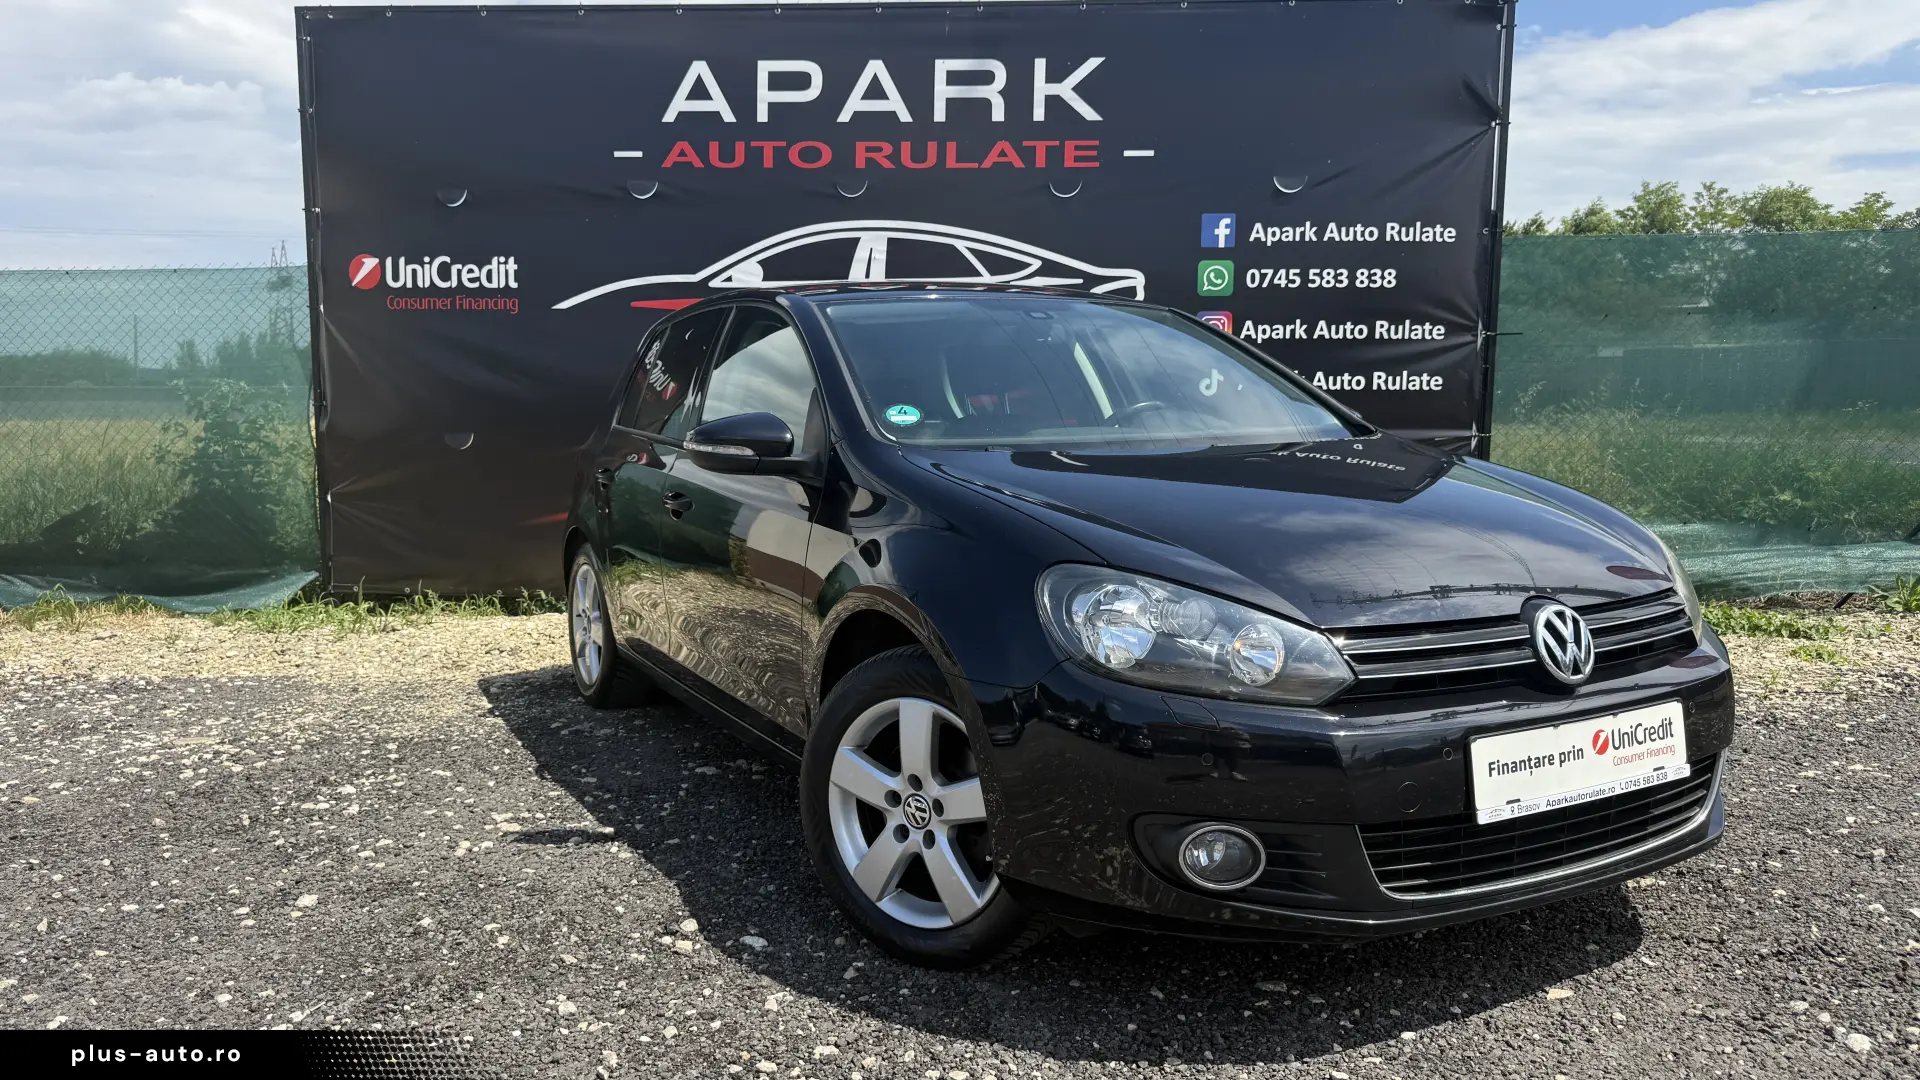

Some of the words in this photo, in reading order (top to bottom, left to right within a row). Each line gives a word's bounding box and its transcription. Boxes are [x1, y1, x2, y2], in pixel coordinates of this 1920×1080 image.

[661, 56, 1106, 123] APARK
[661, 141, 833, 169] AUTO
[855, 140, 1100, 169] RULATE
[1249, 221, 1318, 247] Apark
[1323, 221, 1379, 243] Auto
[1385, 221, 1457, 243] Rulate
[385, 255, 519, 289] UniCredit
[1245, 268, 1301, 289] 0745
[1307, 268, 1349, 289] 583
[1355, 268, 1397, 289] 838
[387, 295, 452, 310] Consumer
[456, 294, 519, 314] Financing
[1239, 319, 1308, 344] Apark
[1313, 319, 1368, 341] Auto
[1374, 319, 1446, 341] Rulate
[1311, 370, 1366, 391] Auto
[1372, 370, 1443, 391] Rulate
[1610, 716, 1674, 751] UniCredit
[1487, 753, 1555, 778] Finanțare
[1558, 745, 1584, 768] prin
[1612, 750, 1645, 767] Consumer
[1646, 743, 1676, 760] Financing
[1545, 785, 1616, 808] Aparkautorulate.ro
[1624, 778, 1641, 790] 0745
[1642, 774, 1655, 787] 583
[1656, 770, 1668, 783] 838
